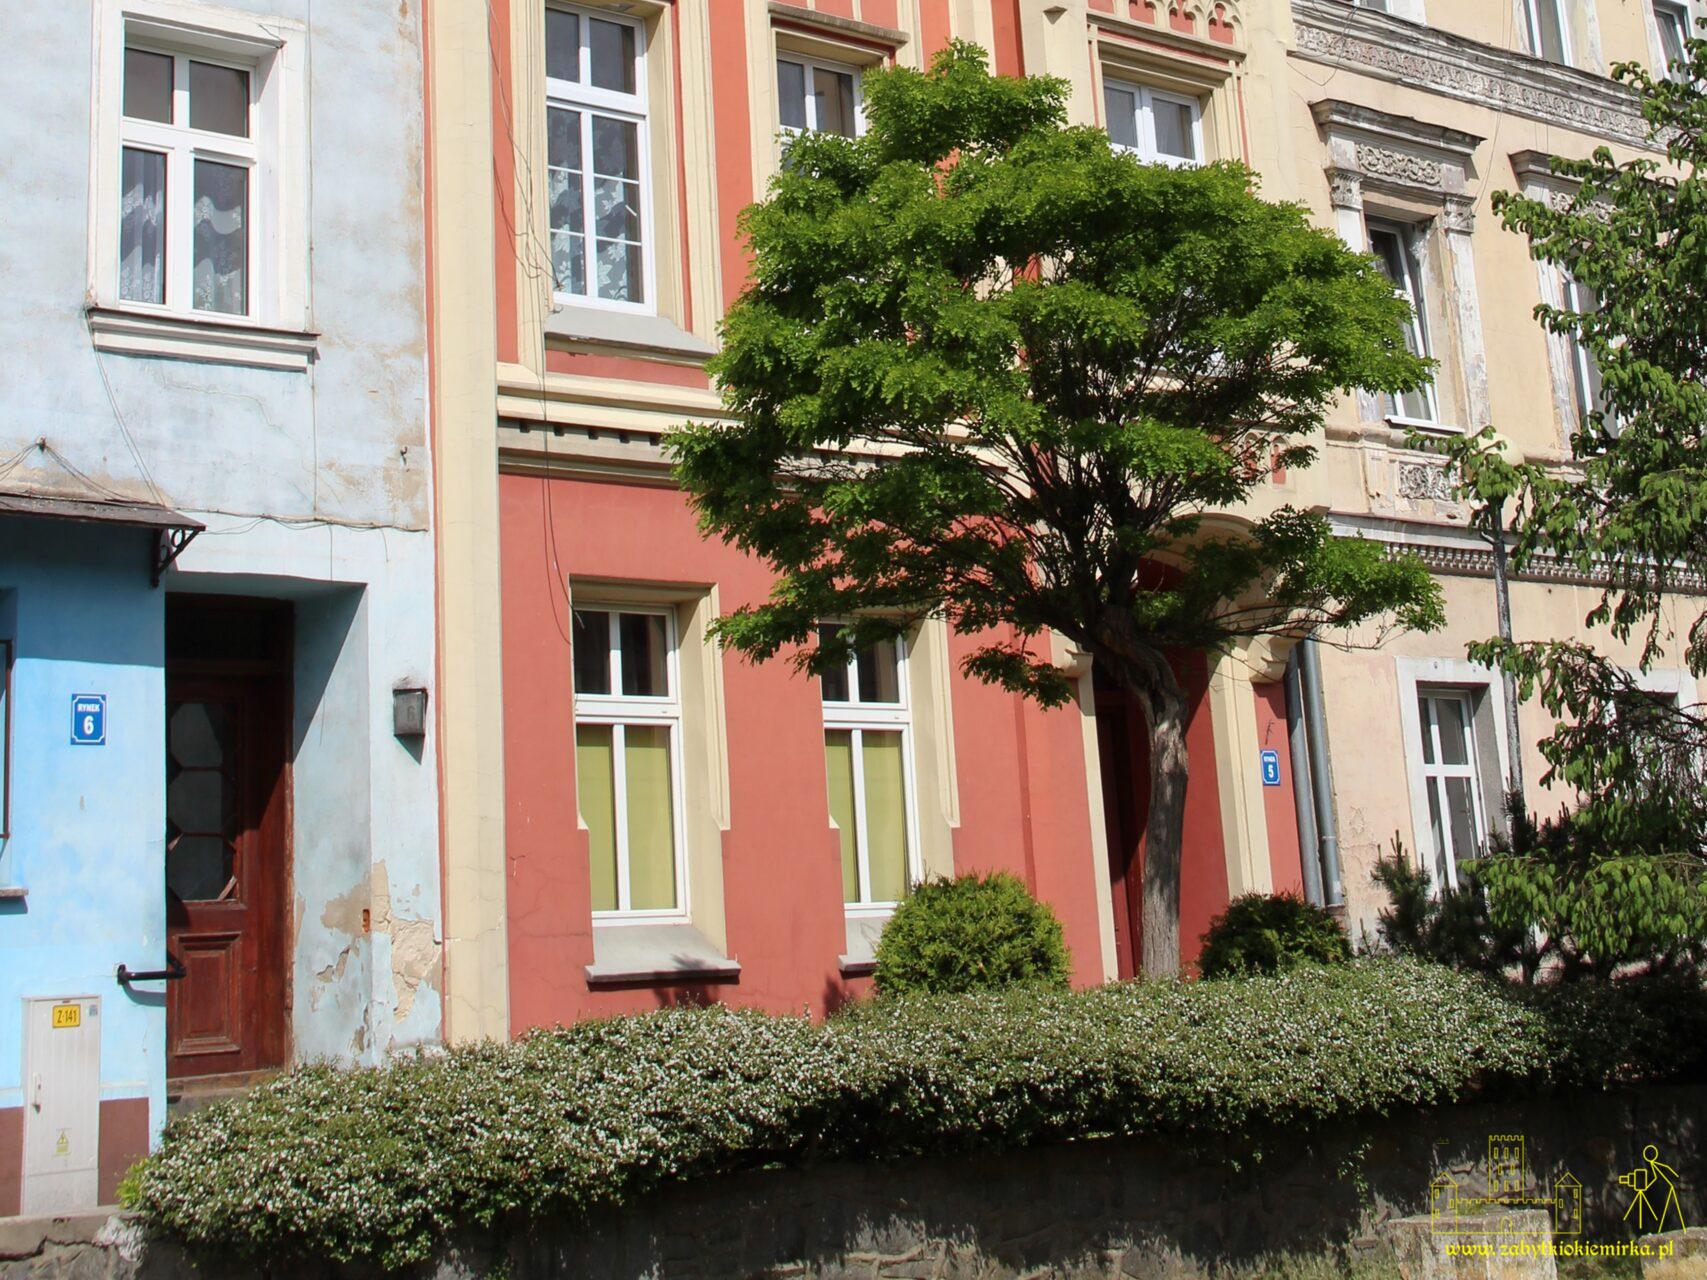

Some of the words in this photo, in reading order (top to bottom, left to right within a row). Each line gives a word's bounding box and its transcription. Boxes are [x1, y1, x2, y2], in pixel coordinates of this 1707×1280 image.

[77, 703, 100, 712] RYNEK
[83, 715, 94, 735] 6
[1268, 763, 1275, 779] 5
